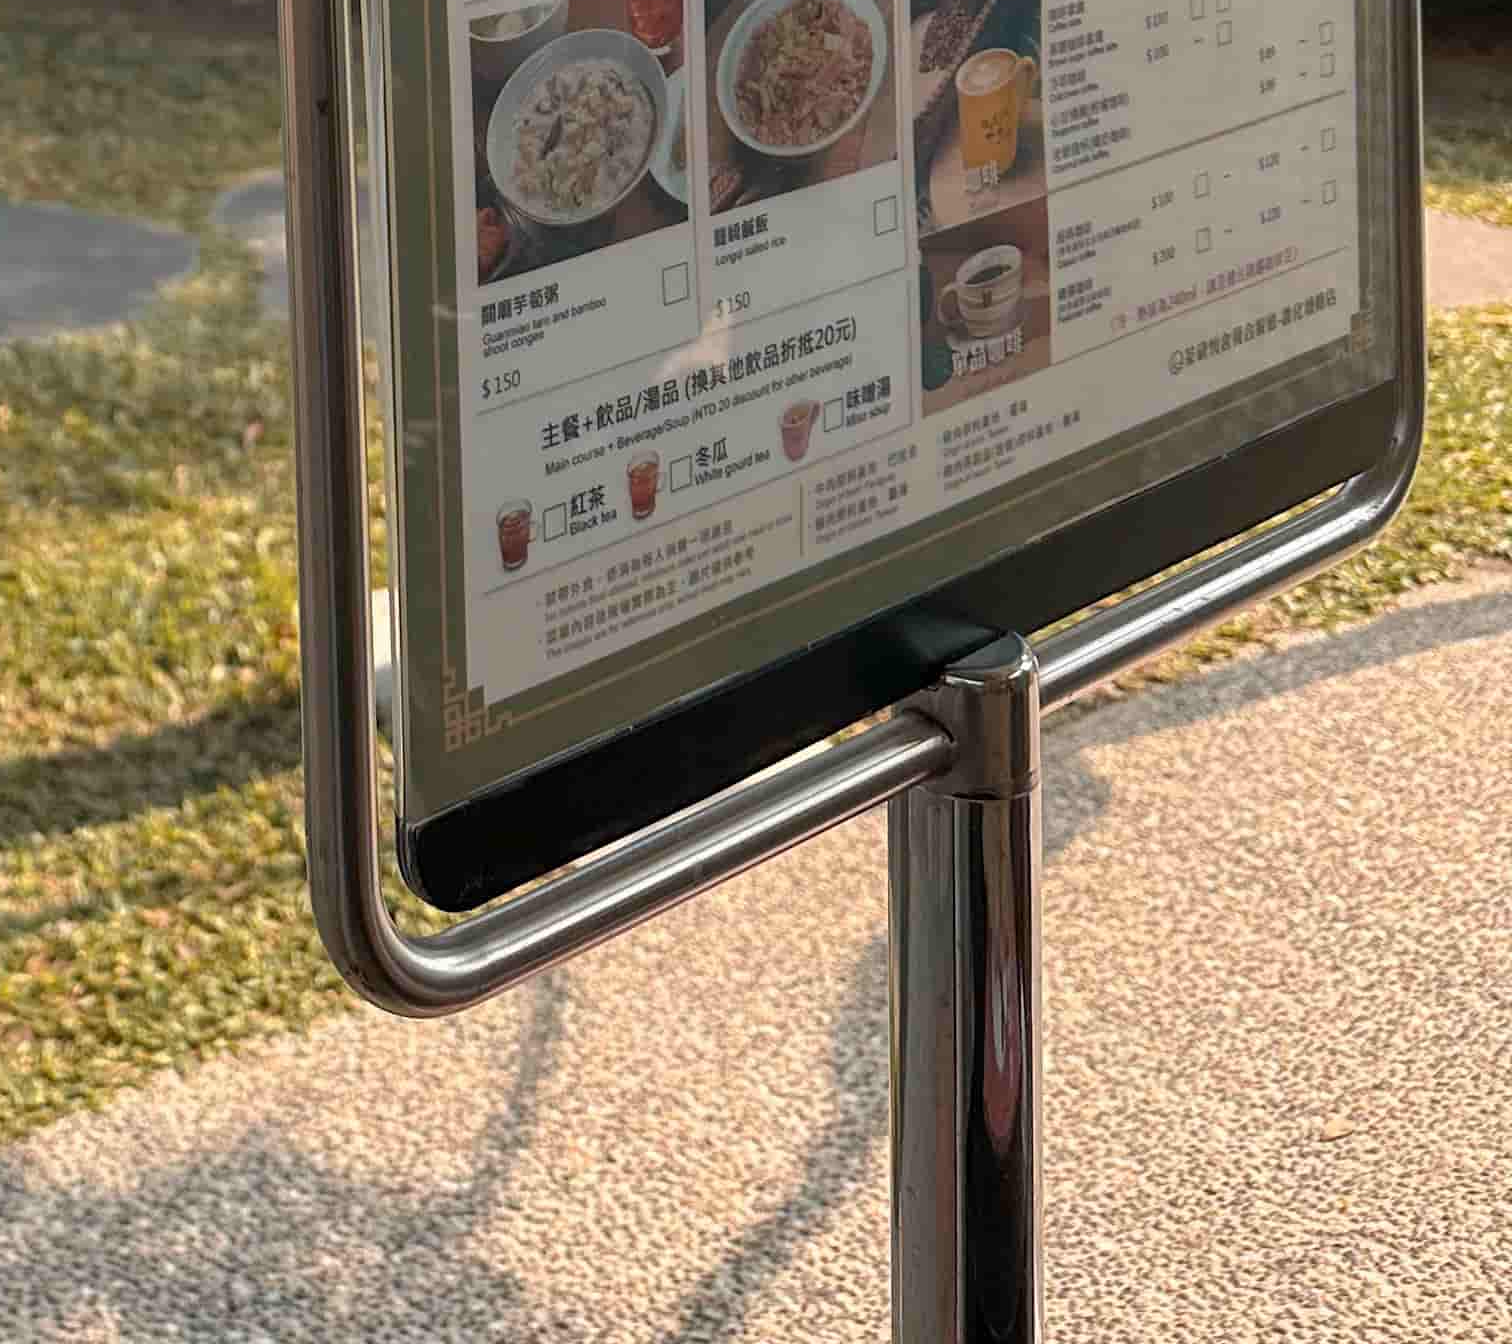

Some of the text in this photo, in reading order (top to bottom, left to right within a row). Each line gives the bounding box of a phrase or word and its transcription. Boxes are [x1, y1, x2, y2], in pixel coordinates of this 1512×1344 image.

[571, 297, 607, 317] bamboo
[545, 458, 570, 477] Main
[572, 446, 606, 467] course
[718, 396, 731, 413] 20
[732, 384, 771, 407] discount
[695, 437, 728, 467] 冬瓜
[695, 465, 723, 486] White
[754, 448, 770, 463] tea
[570, 484, 605, 518] 紅茶
[569, 508, 618, 536] Black tea
